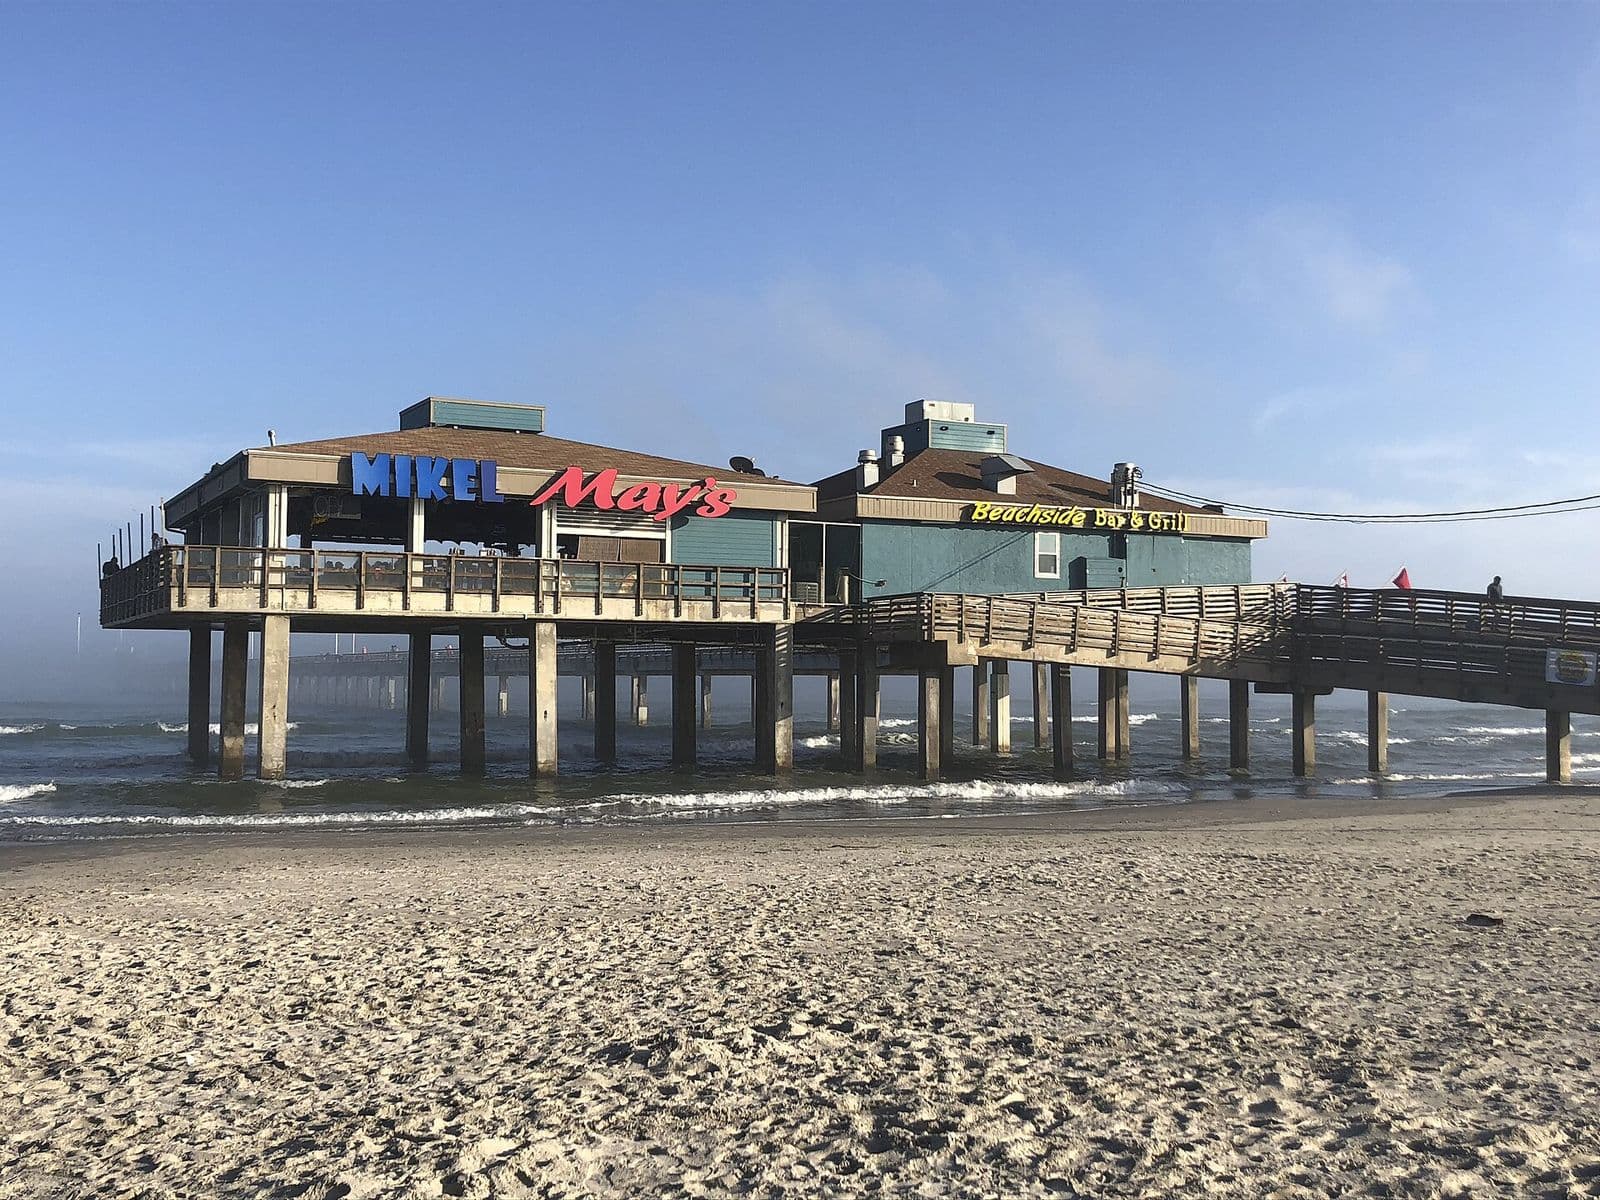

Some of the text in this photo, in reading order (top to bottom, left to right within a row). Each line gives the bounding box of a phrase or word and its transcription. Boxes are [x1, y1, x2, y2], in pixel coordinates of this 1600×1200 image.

[351, 451, 738, 521] MIKEL May's
[972, 501, 1188, 532] Beachside Bar & Grill
